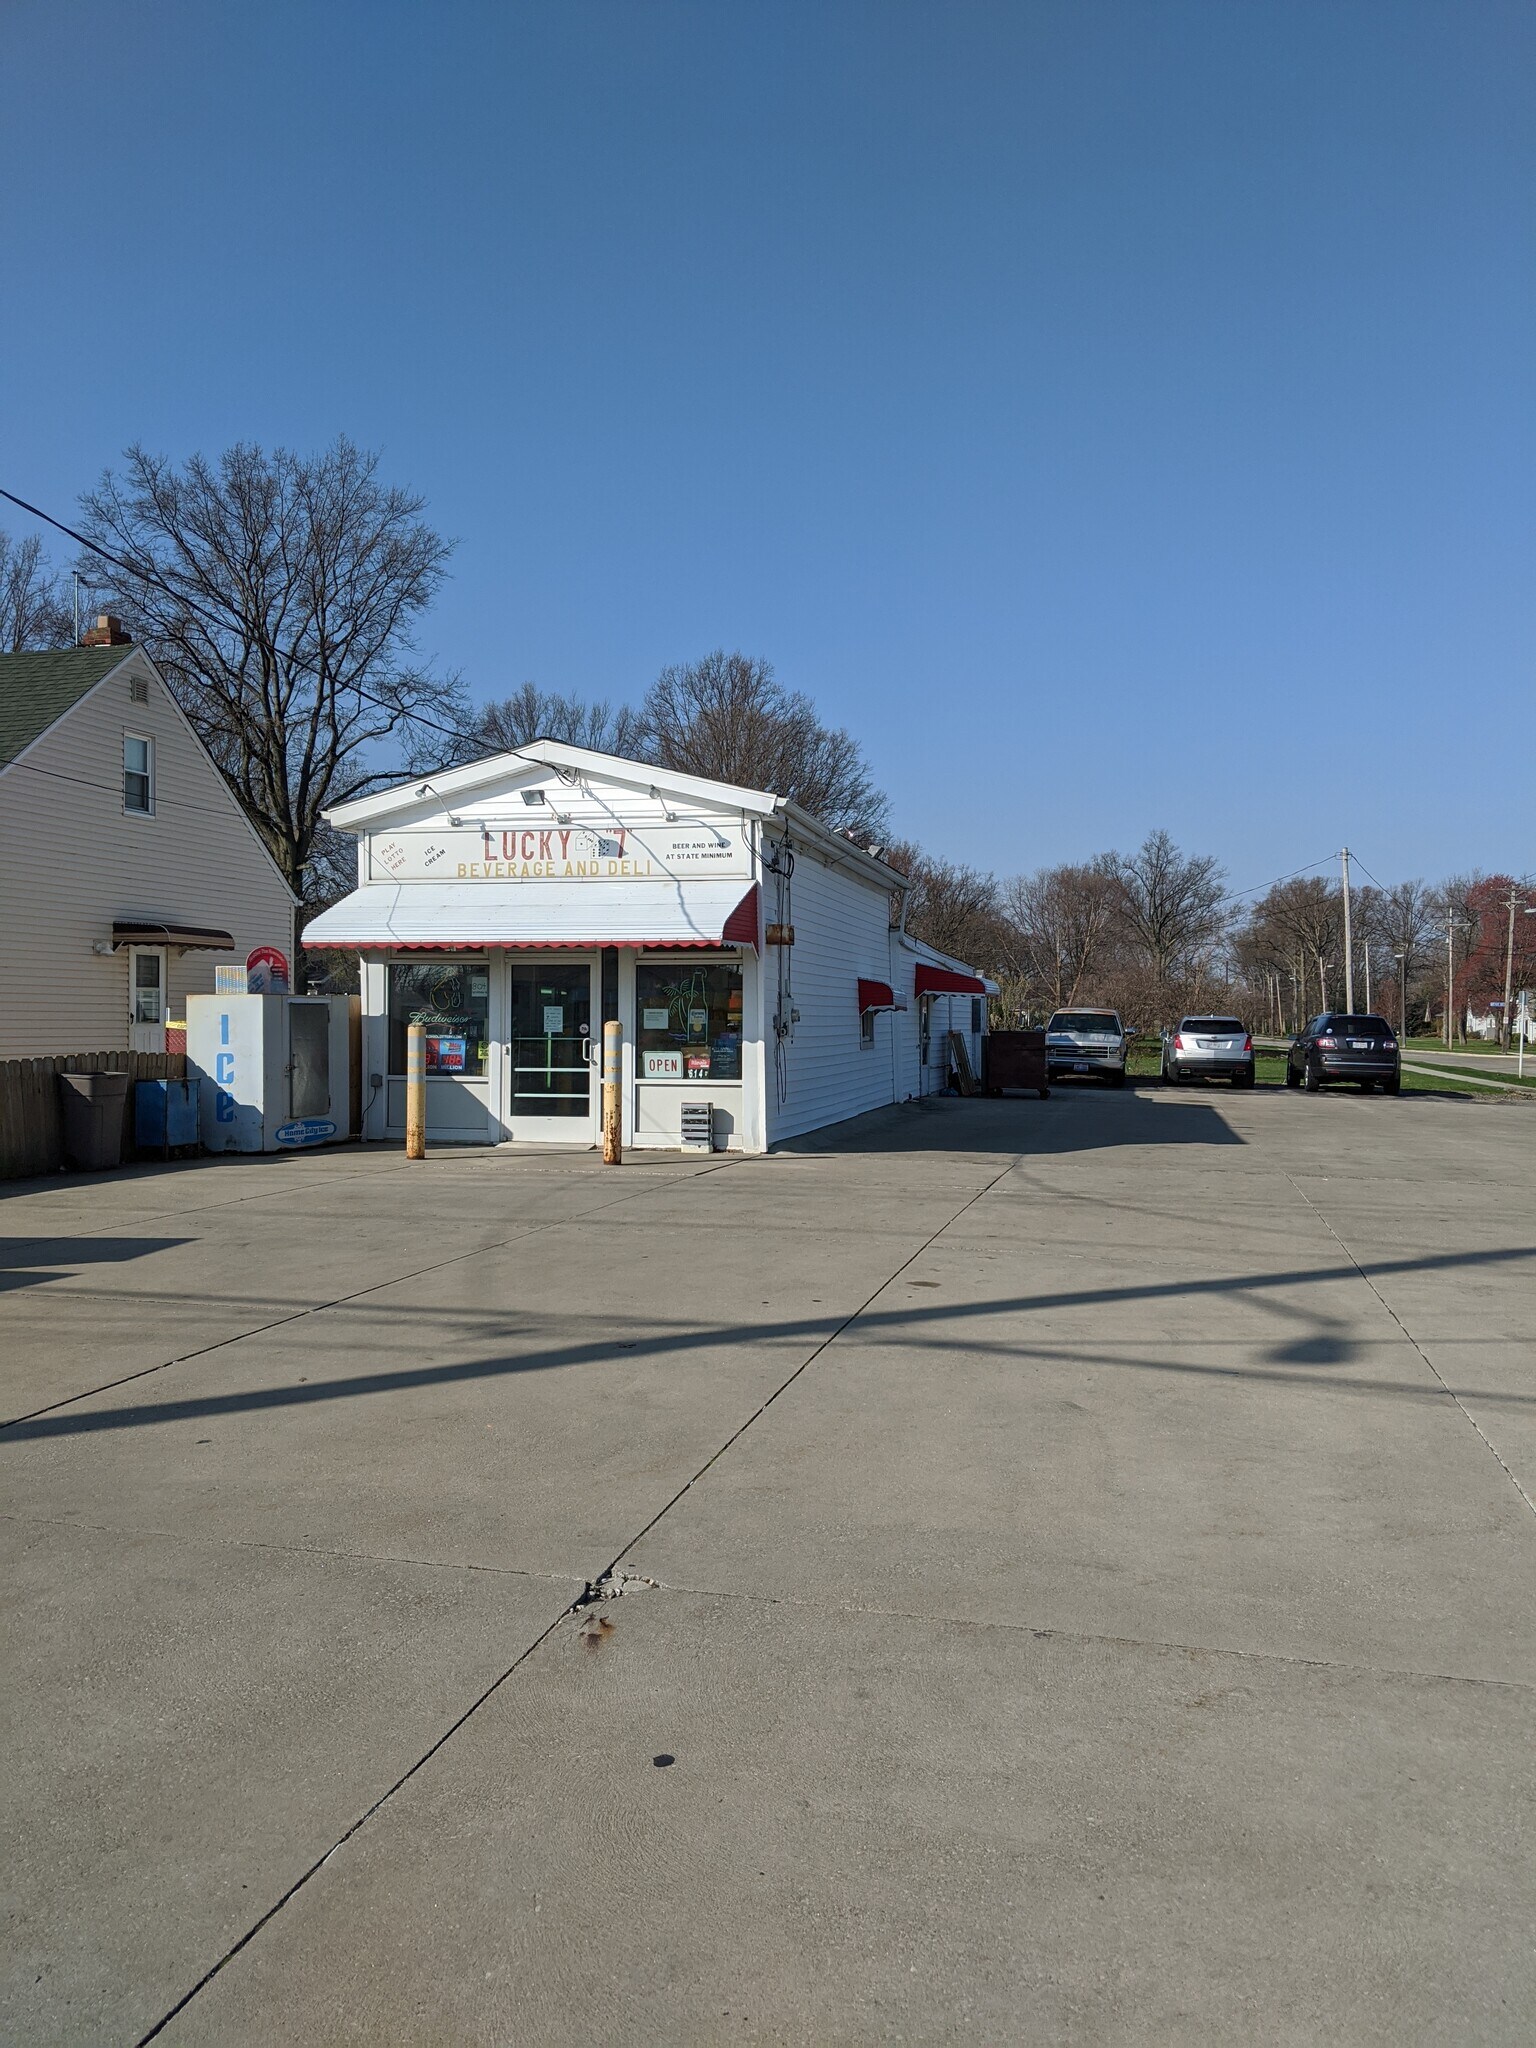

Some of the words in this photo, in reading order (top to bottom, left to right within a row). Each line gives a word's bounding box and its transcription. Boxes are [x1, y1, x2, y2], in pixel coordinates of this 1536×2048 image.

[381, 842, 396, 856] PLAY
[424, 845, 436, 856] ICE
[485, 831, 572, 860] LUCKY
[383, 847, 404, 865] LOTTO
[424, 849, 446, 867] CREAM
[391, 856, 407, 871] HERE
[457, 861, 556, 878] BEVERAGE
[564, 860, 600, 876] AND
[608, 859, 651, 876] DELI
[408, 1011, 472, 1023] Budweiser
[649, 1059, 678, 1072] OPEN
[284, 1129, 305, 1137] Home
[305, 1127, 318, 1135] City
